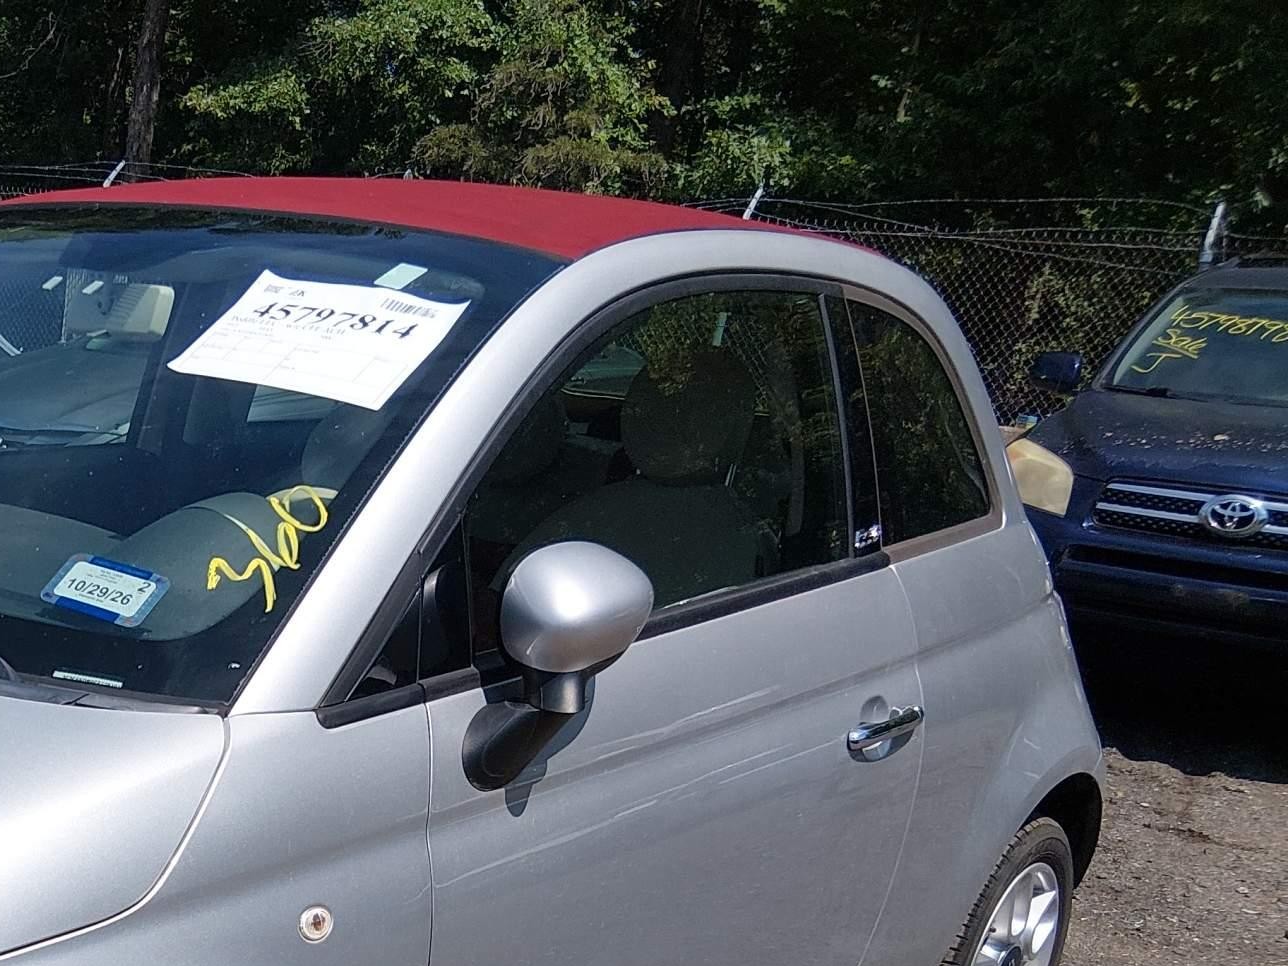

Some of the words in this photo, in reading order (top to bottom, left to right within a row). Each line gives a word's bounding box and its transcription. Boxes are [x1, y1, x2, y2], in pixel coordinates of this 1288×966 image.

[253, 302, 418, 339] 45797814
[207, 485, 329, 613] 360
[66, 578, 133, 606] 10/29/26
[137, 581, 151, 593] 2
